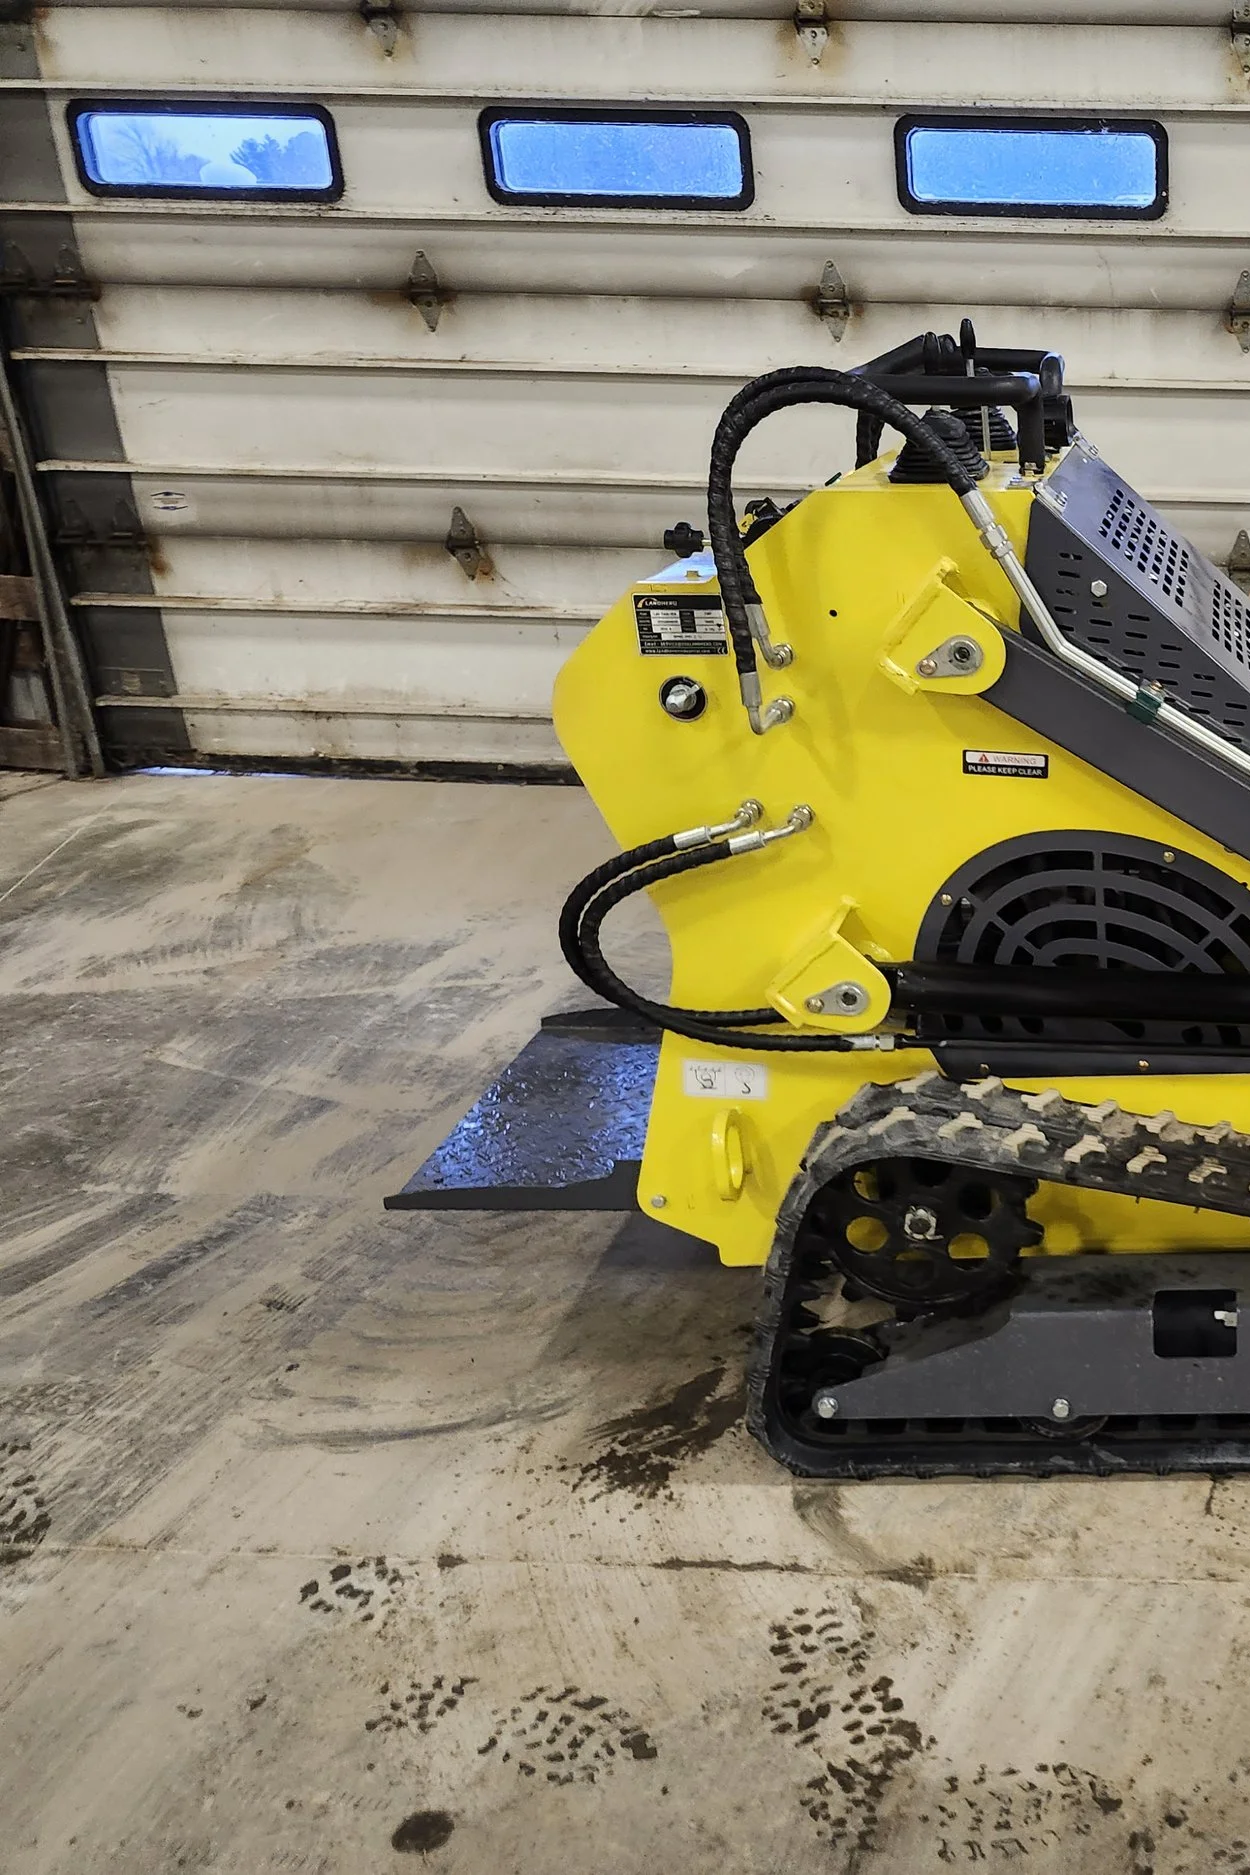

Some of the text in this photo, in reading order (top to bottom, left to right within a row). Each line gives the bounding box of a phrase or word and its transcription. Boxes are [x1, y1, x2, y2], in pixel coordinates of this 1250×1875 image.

[992, 755, 1037, 765] WARNING
[968, 765, 1043, 776] PLEASE KEEP CLEAR
